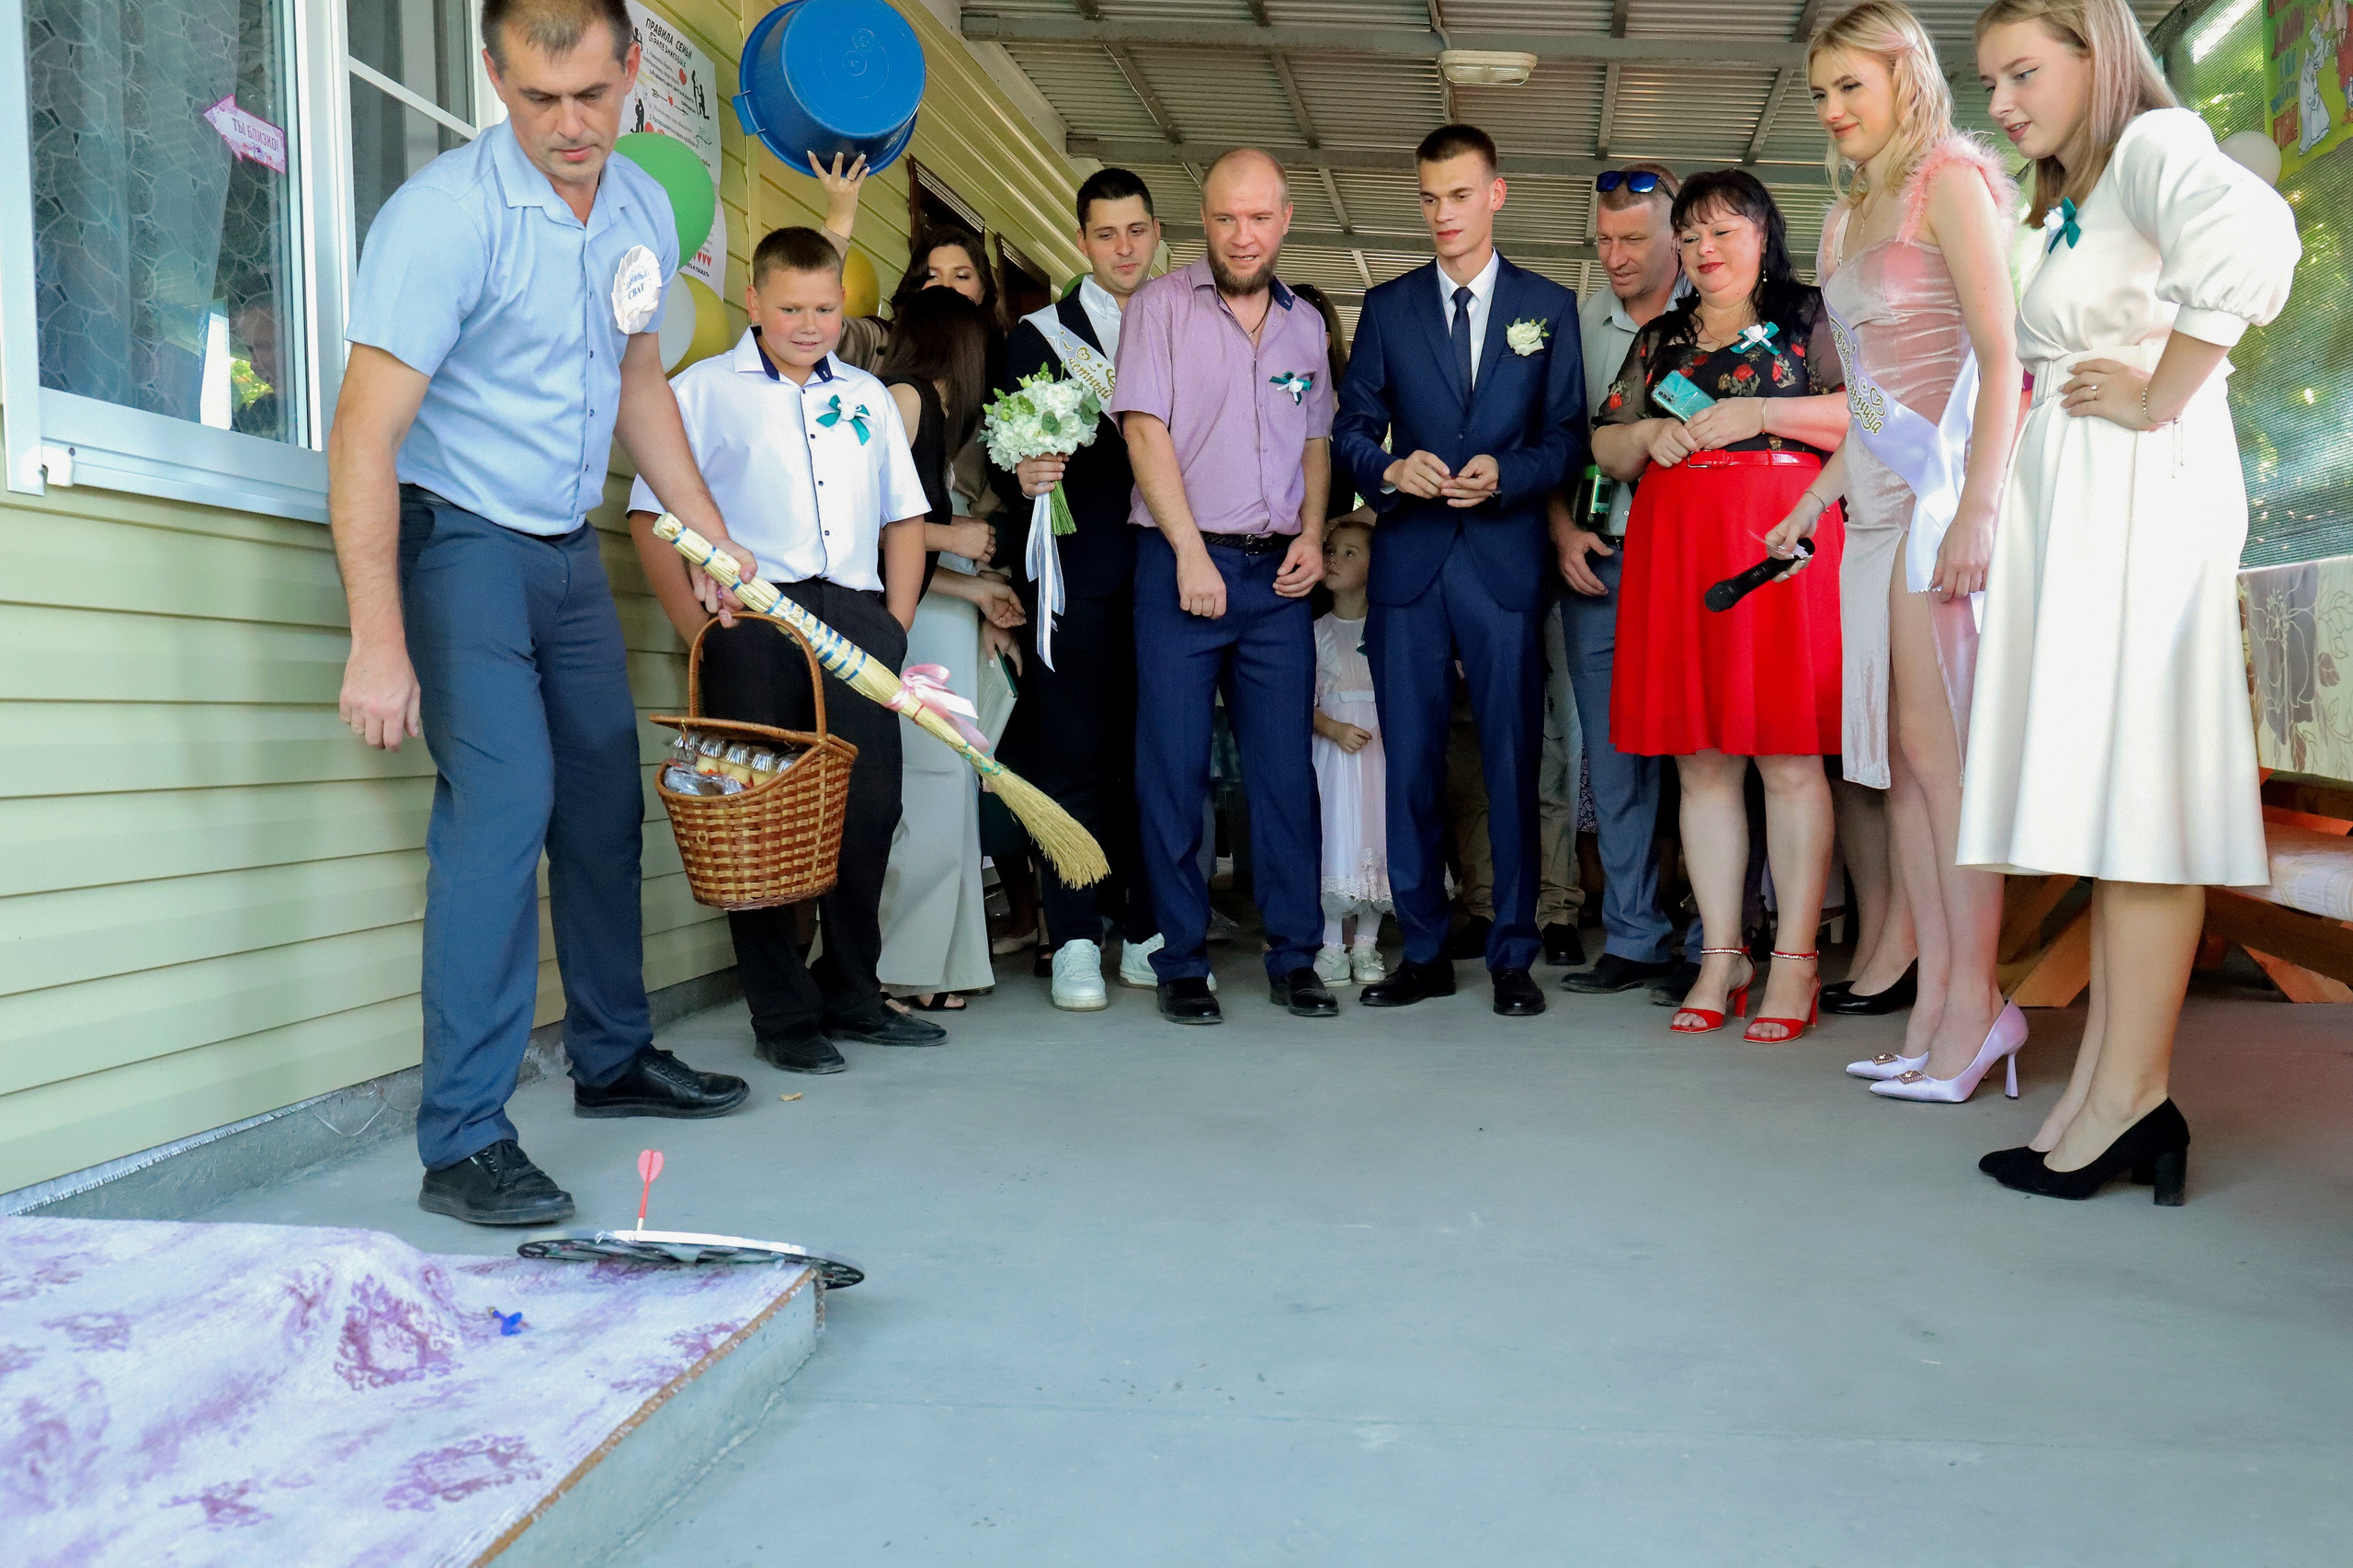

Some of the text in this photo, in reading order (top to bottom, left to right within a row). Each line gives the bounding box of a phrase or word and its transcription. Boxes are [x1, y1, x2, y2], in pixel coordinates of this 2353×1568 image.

[645, 17, 693, 60] ПРАВИЛА СЕМЬИ
[232, 118, 279, 153] ТЫ БЛИЗКО!
[628, 282, 645, 301] СВАТ
